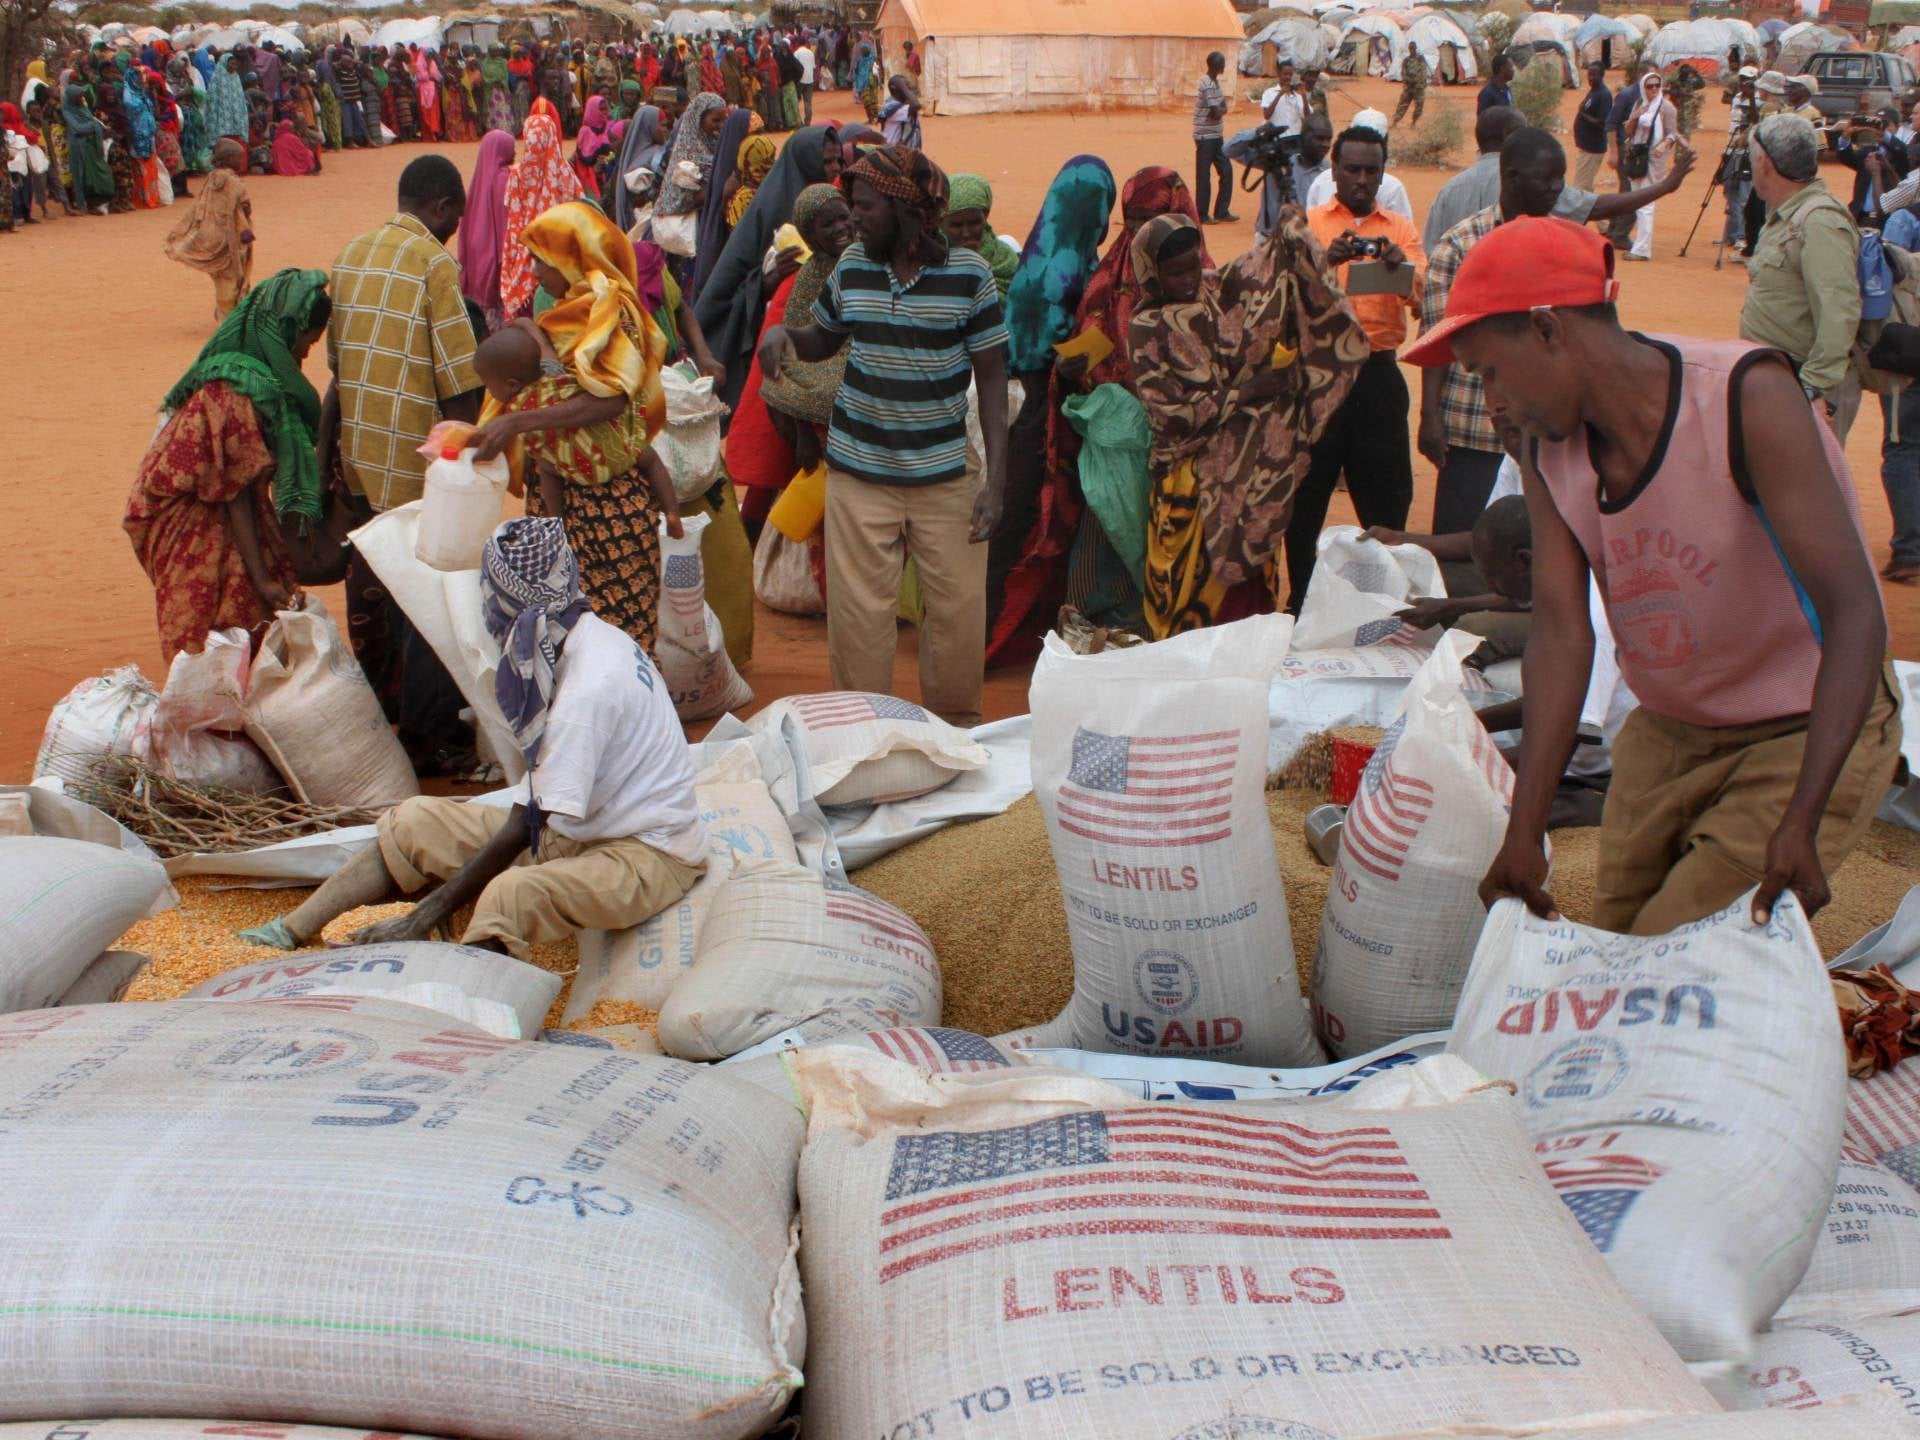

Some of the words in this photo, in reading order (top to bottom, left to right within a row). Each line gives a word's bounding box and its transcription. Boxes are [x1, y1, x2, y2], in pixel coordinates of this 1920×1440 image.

[1092, 858, 1198, 892] LENTILS
[1088, 904, 1102, 919] TO
[1105, 911, 1121, 925] BE
[1124, 915, 1159, 931] SOLD
[1163, 919, 1182, 931] OR
[1186, 901, 1257, 931] EXCHANGED
[1335, 921, 1394, 956] EXCHANGED
[213, 956, 405, 997] USAID
[1102, 1001, 1243, 1049] USAID
[1496, 984, 1717, 1036] USAID
[1828, 1221, 1842, 1233] 23
[1856, 1219, 1869, 1230] 37
[1838, 1201, 1854, 1213] 50
[1003, 1264, 1347, 1322] LENTILS
[951, 1386, 1011, 1420] TO
[1025, 1370, 1088, 1401] BE
[1100, 1356, 1224, 1389] SOLD
[1237, 1352, 1299, 1378] OR
[1314, 1341, 1582, 1377] EXCHANGED
